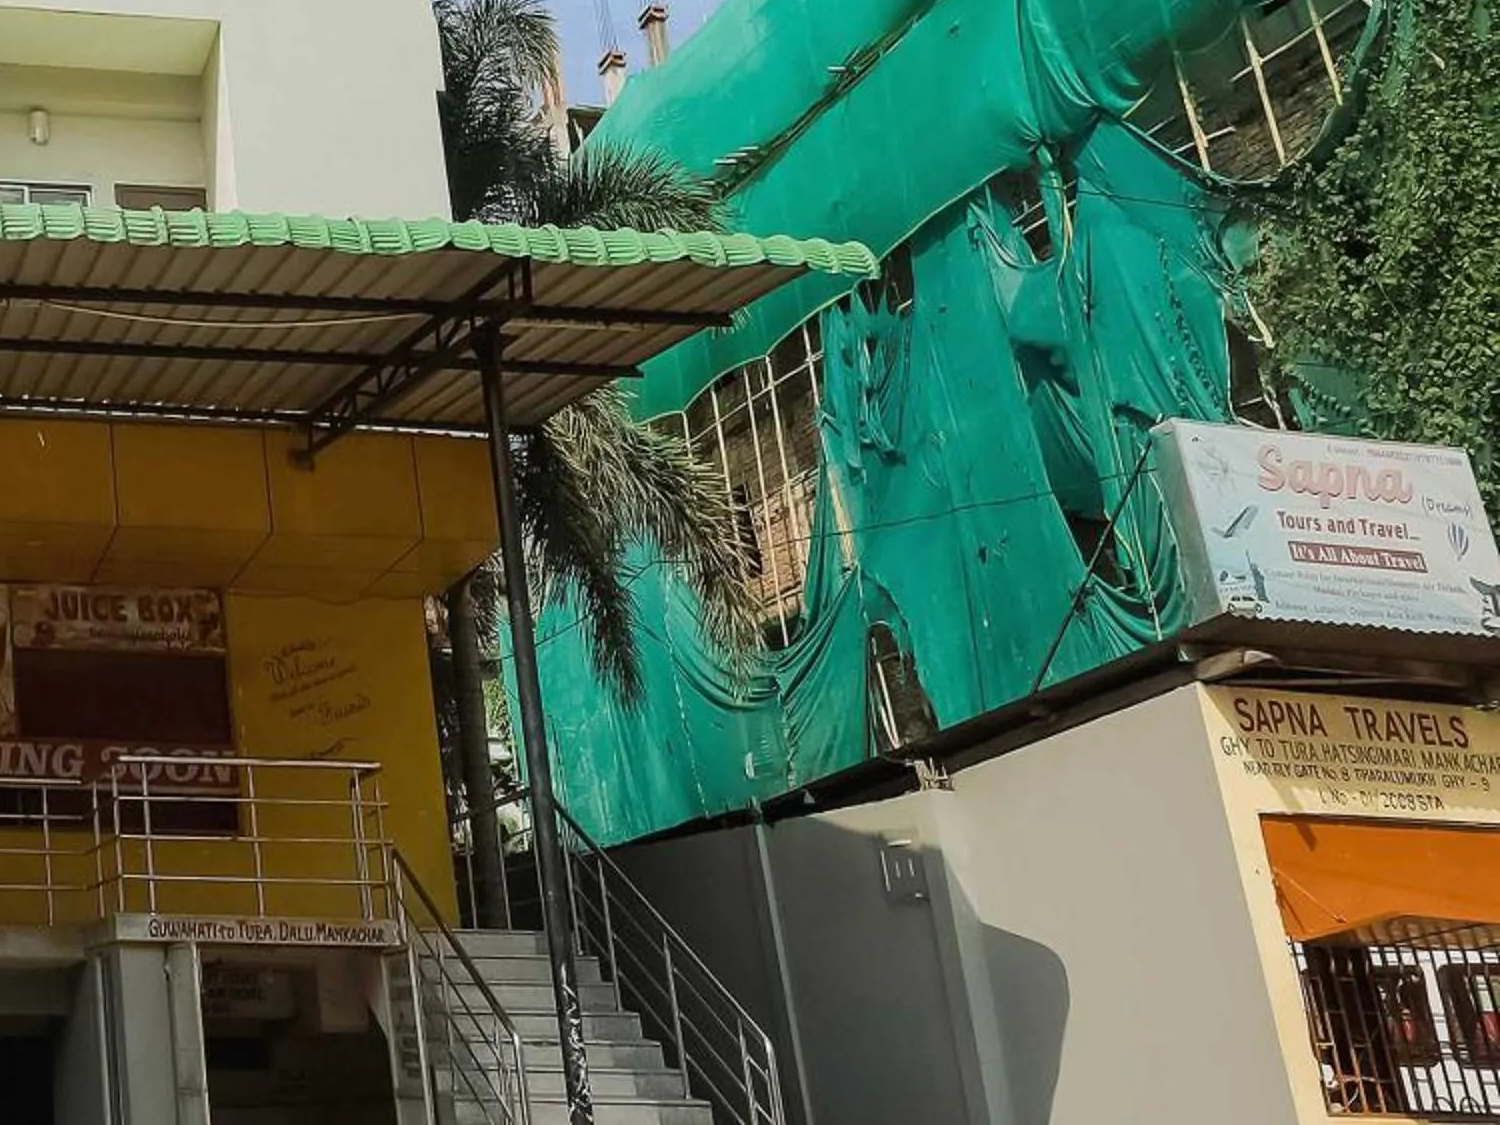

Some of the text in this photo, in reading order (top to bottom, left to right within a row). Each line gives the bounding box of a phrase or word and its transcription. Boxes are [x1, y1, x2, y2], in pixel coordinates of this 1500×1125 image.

[1257, 445, 1414, 509] Sapna
[1277, 510, 1323, 532] Tours
[1327, 517, 1356, 534] and
[1291, 543, 1426, 571] It's All About Travel
[45, 592, 129, 623] JUICE
[1233, 698, 1469, 749] SAPNA TRAVELS
[1220, 736, 1250, 756] GHY
[1255, 738, 1275, 758] TO
[101, 744, 236, 784] SOON
